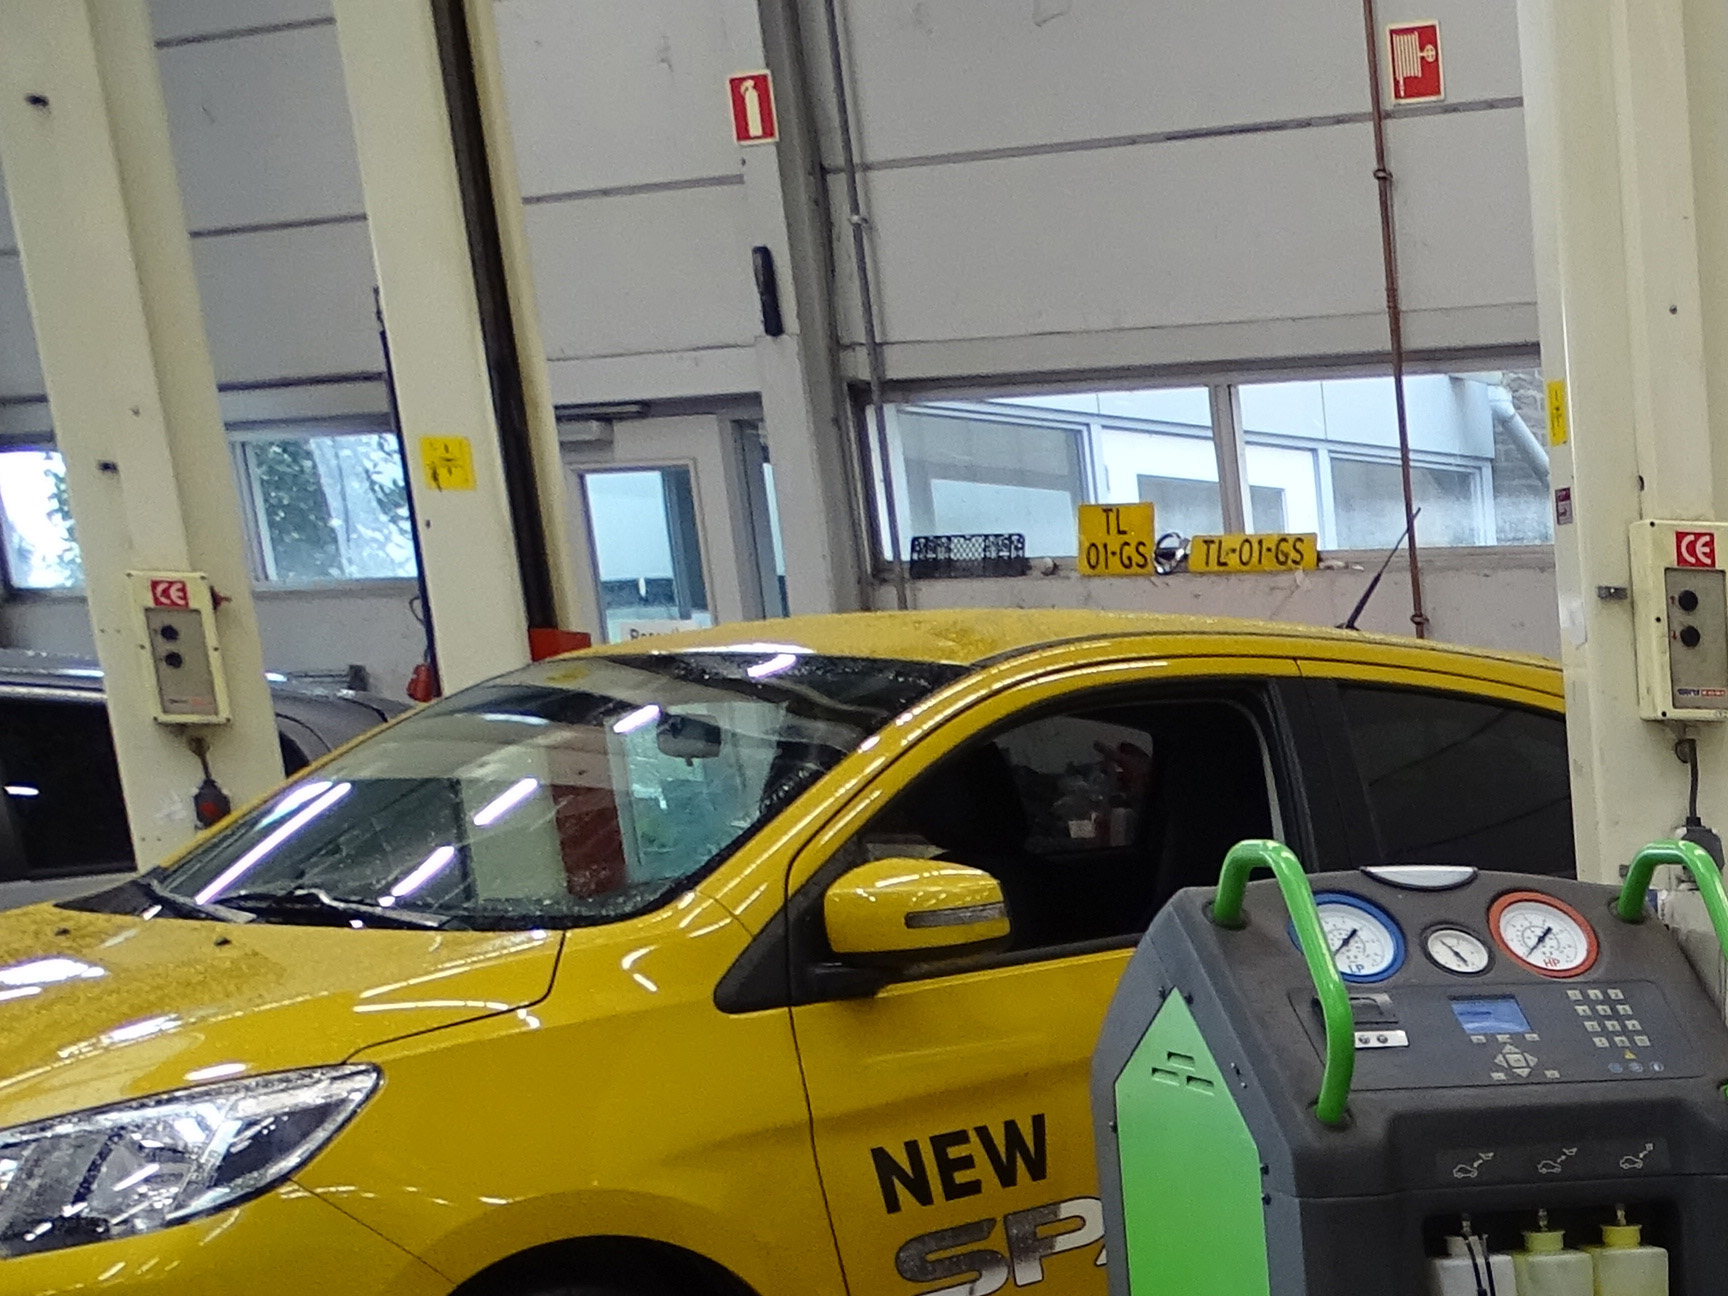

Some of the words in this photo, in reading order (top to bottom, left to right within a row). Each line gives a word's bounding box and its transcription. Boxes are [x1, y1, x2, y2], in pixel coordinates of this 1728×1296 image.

[1101, 507, 1128, 536] TL
[1680, 533, 1712, 565] CE
[154, 582, 186, 606] CE
[1348, 963, 1365, 974] LP
[1542, 957, 1561, 968] HP
[870, 1112, 1048, 1215] NEW
